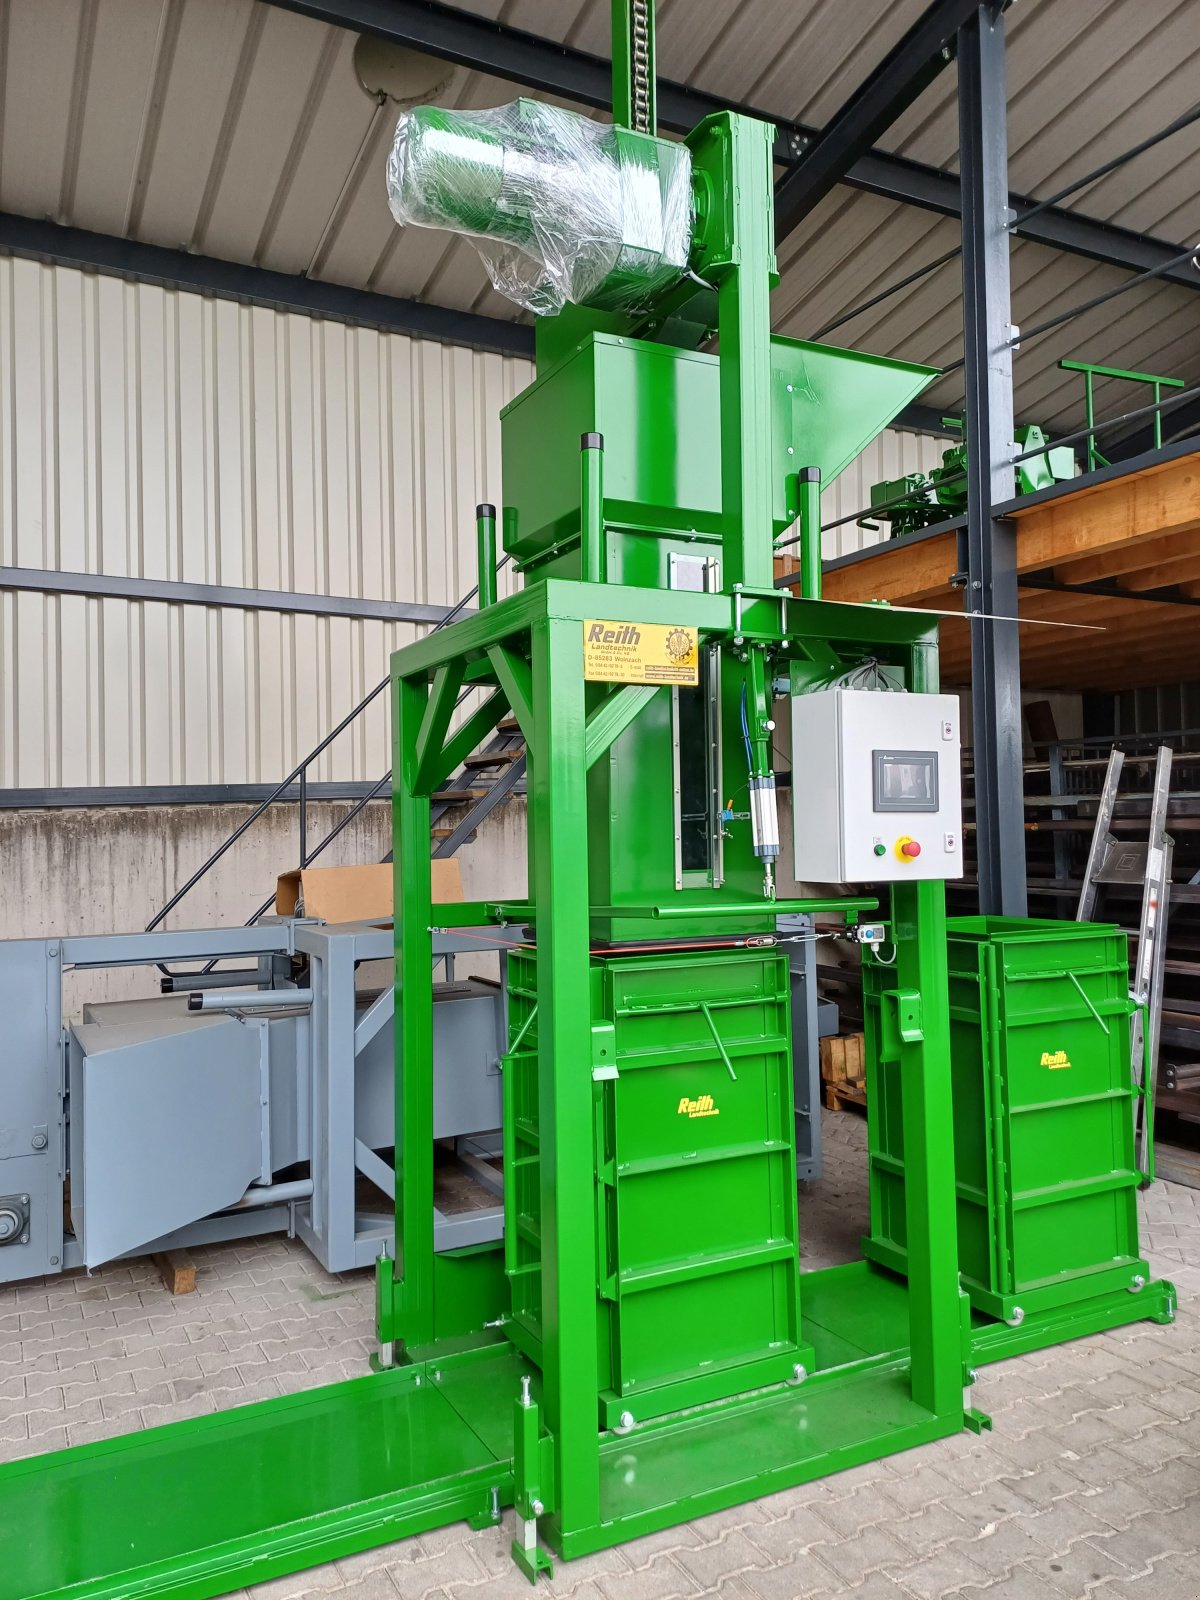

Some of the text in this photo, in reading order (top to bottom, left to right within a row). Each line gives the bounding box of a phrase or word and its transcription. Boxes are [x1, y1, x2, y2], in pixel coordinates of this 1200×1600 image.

[588, 623, 641, 645] Reith
[591, 643, 637, 652] Landtechnik
[1040, 1050, 1067, 1066] Reith
[677, 1095, 714, 1114] Reith
